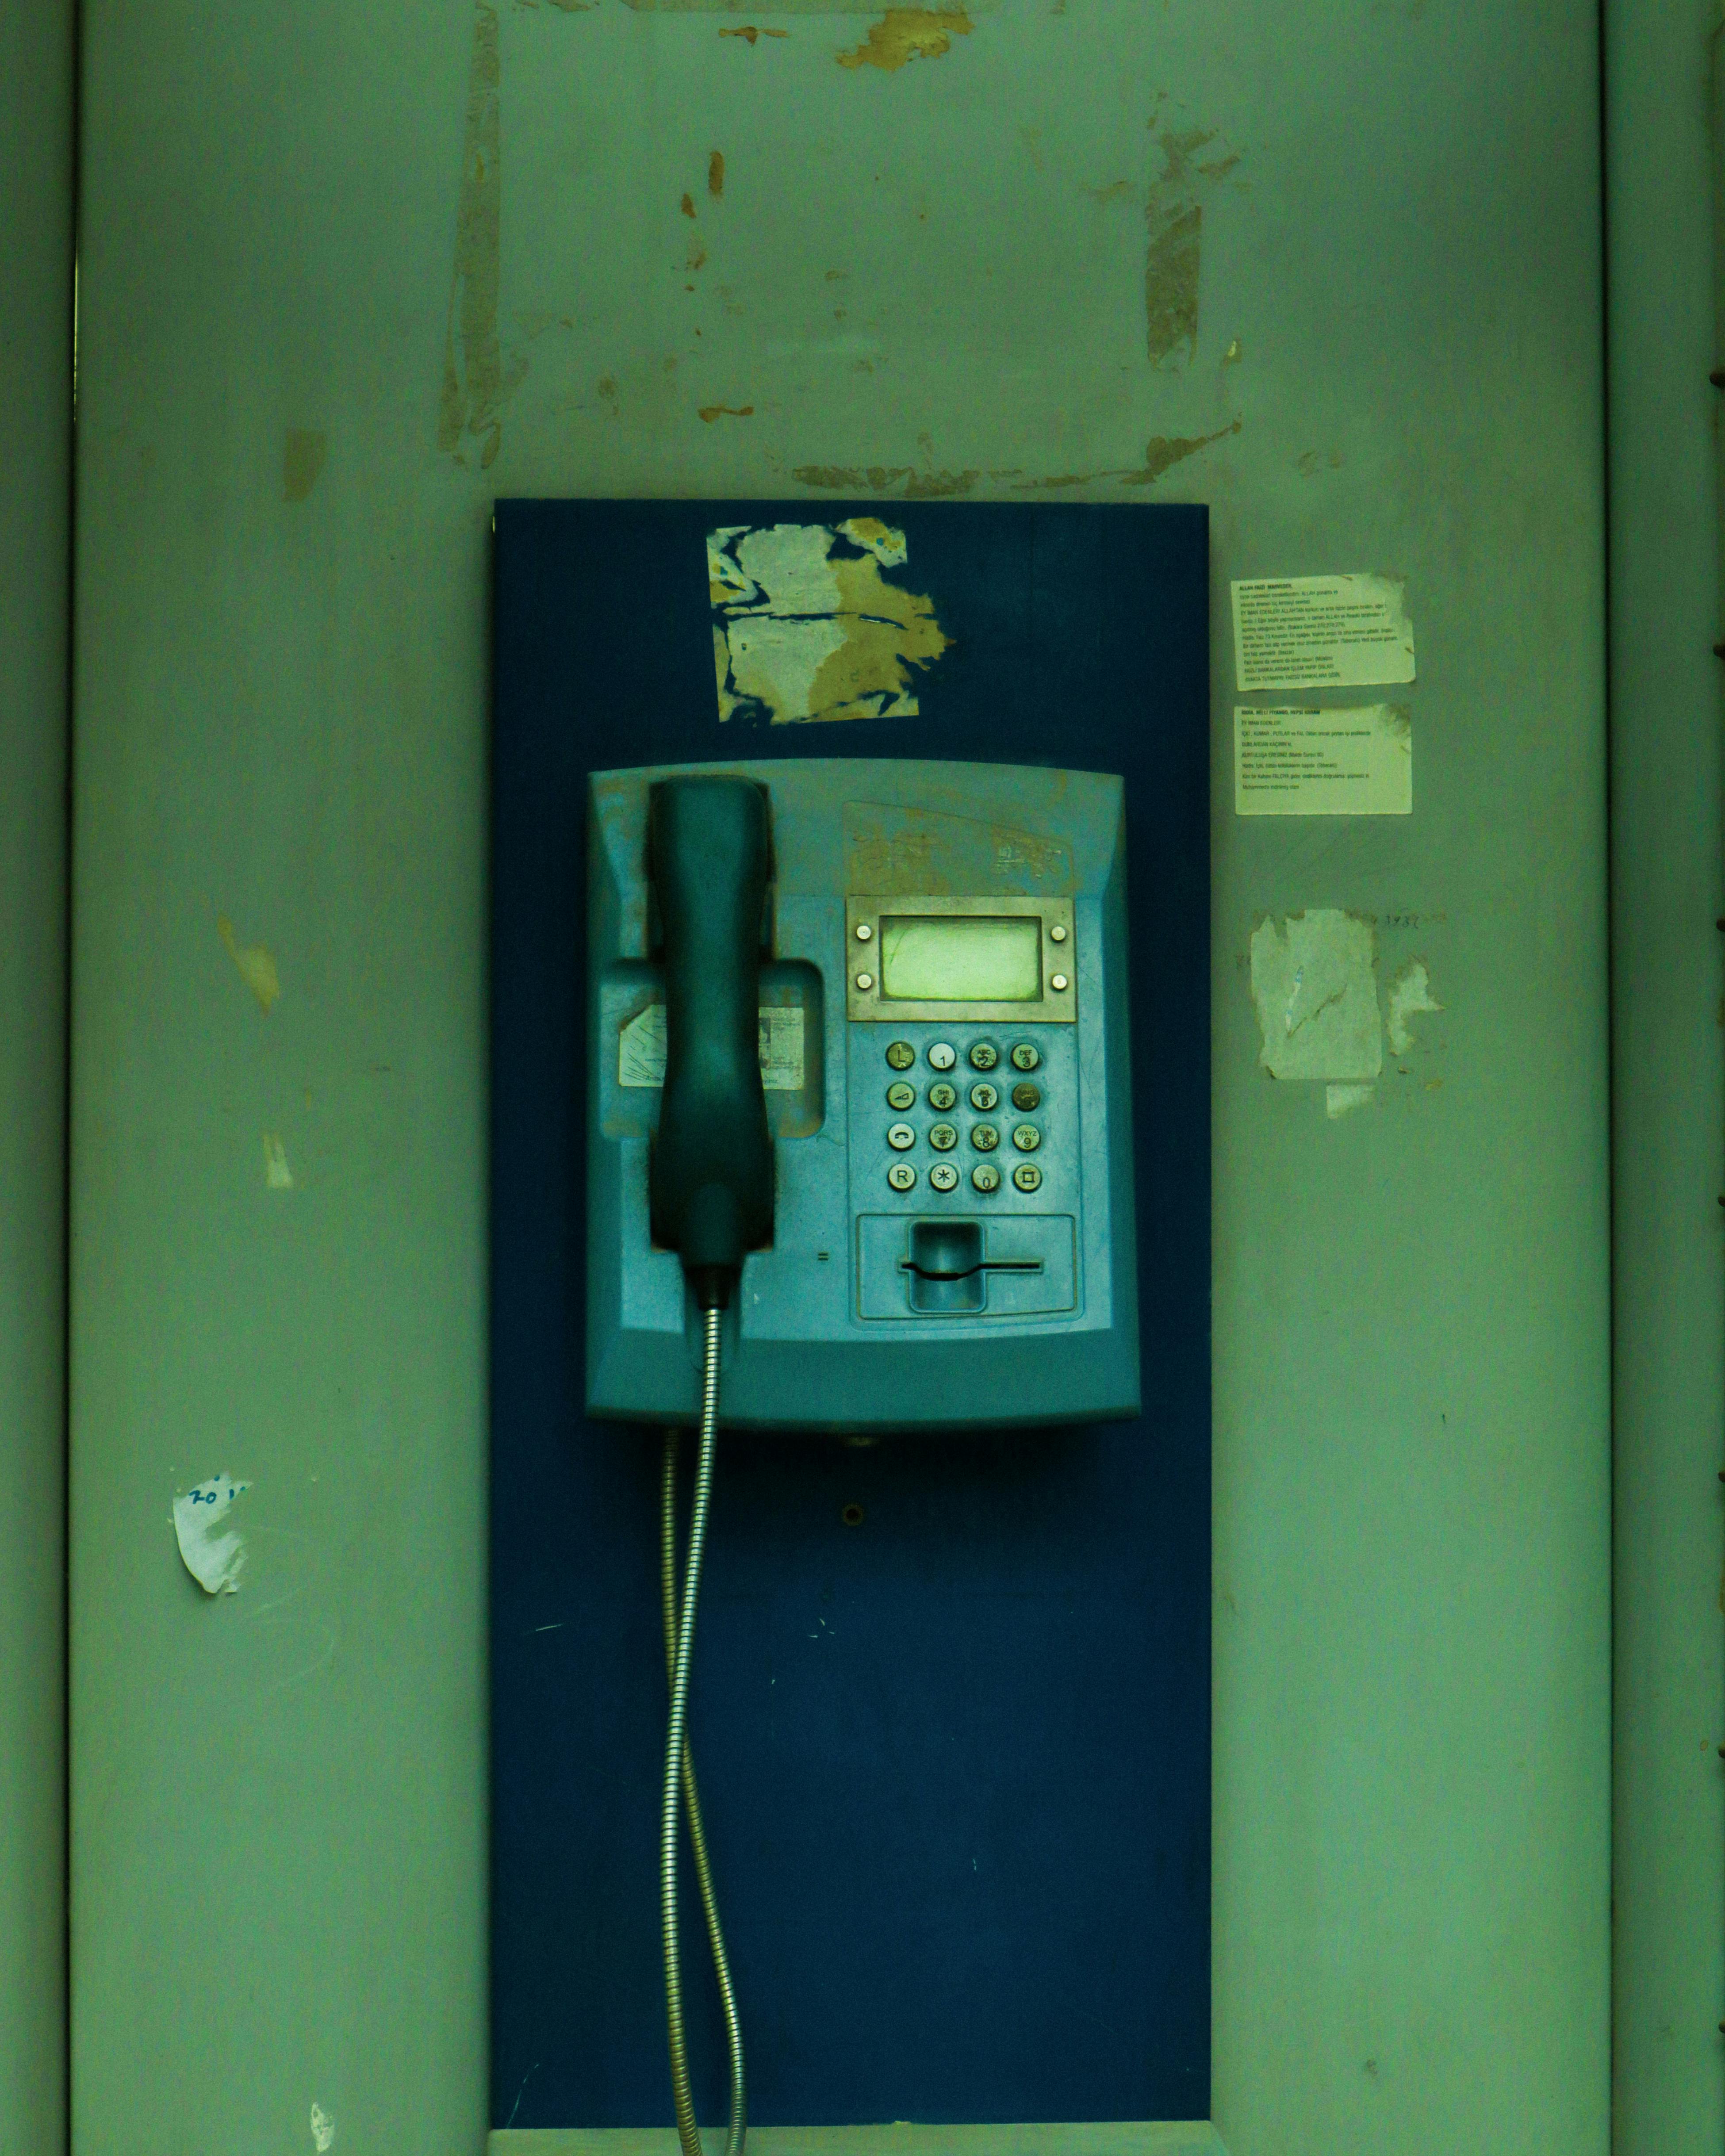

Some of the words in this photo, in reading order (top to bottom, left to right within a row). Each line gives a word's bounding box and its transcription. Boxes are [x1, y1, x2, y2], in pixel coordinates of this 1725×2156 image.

[897, 1050, 905, 1061] L
[940, 1056, 946, 1066] 1
[979, 1057, 990, 1067] 2
[1023, 1057, 1030, 1067] 3
[939, 1096, 947, 1107] 4
[982, 1137, 990, 1148] 8
[1024, 1137, 1031, 1148] 9
[897, 1170, 908, 1183] R
[983, 1177, 990, 1188] 0
[189, 1490, 217, 1505] 20
